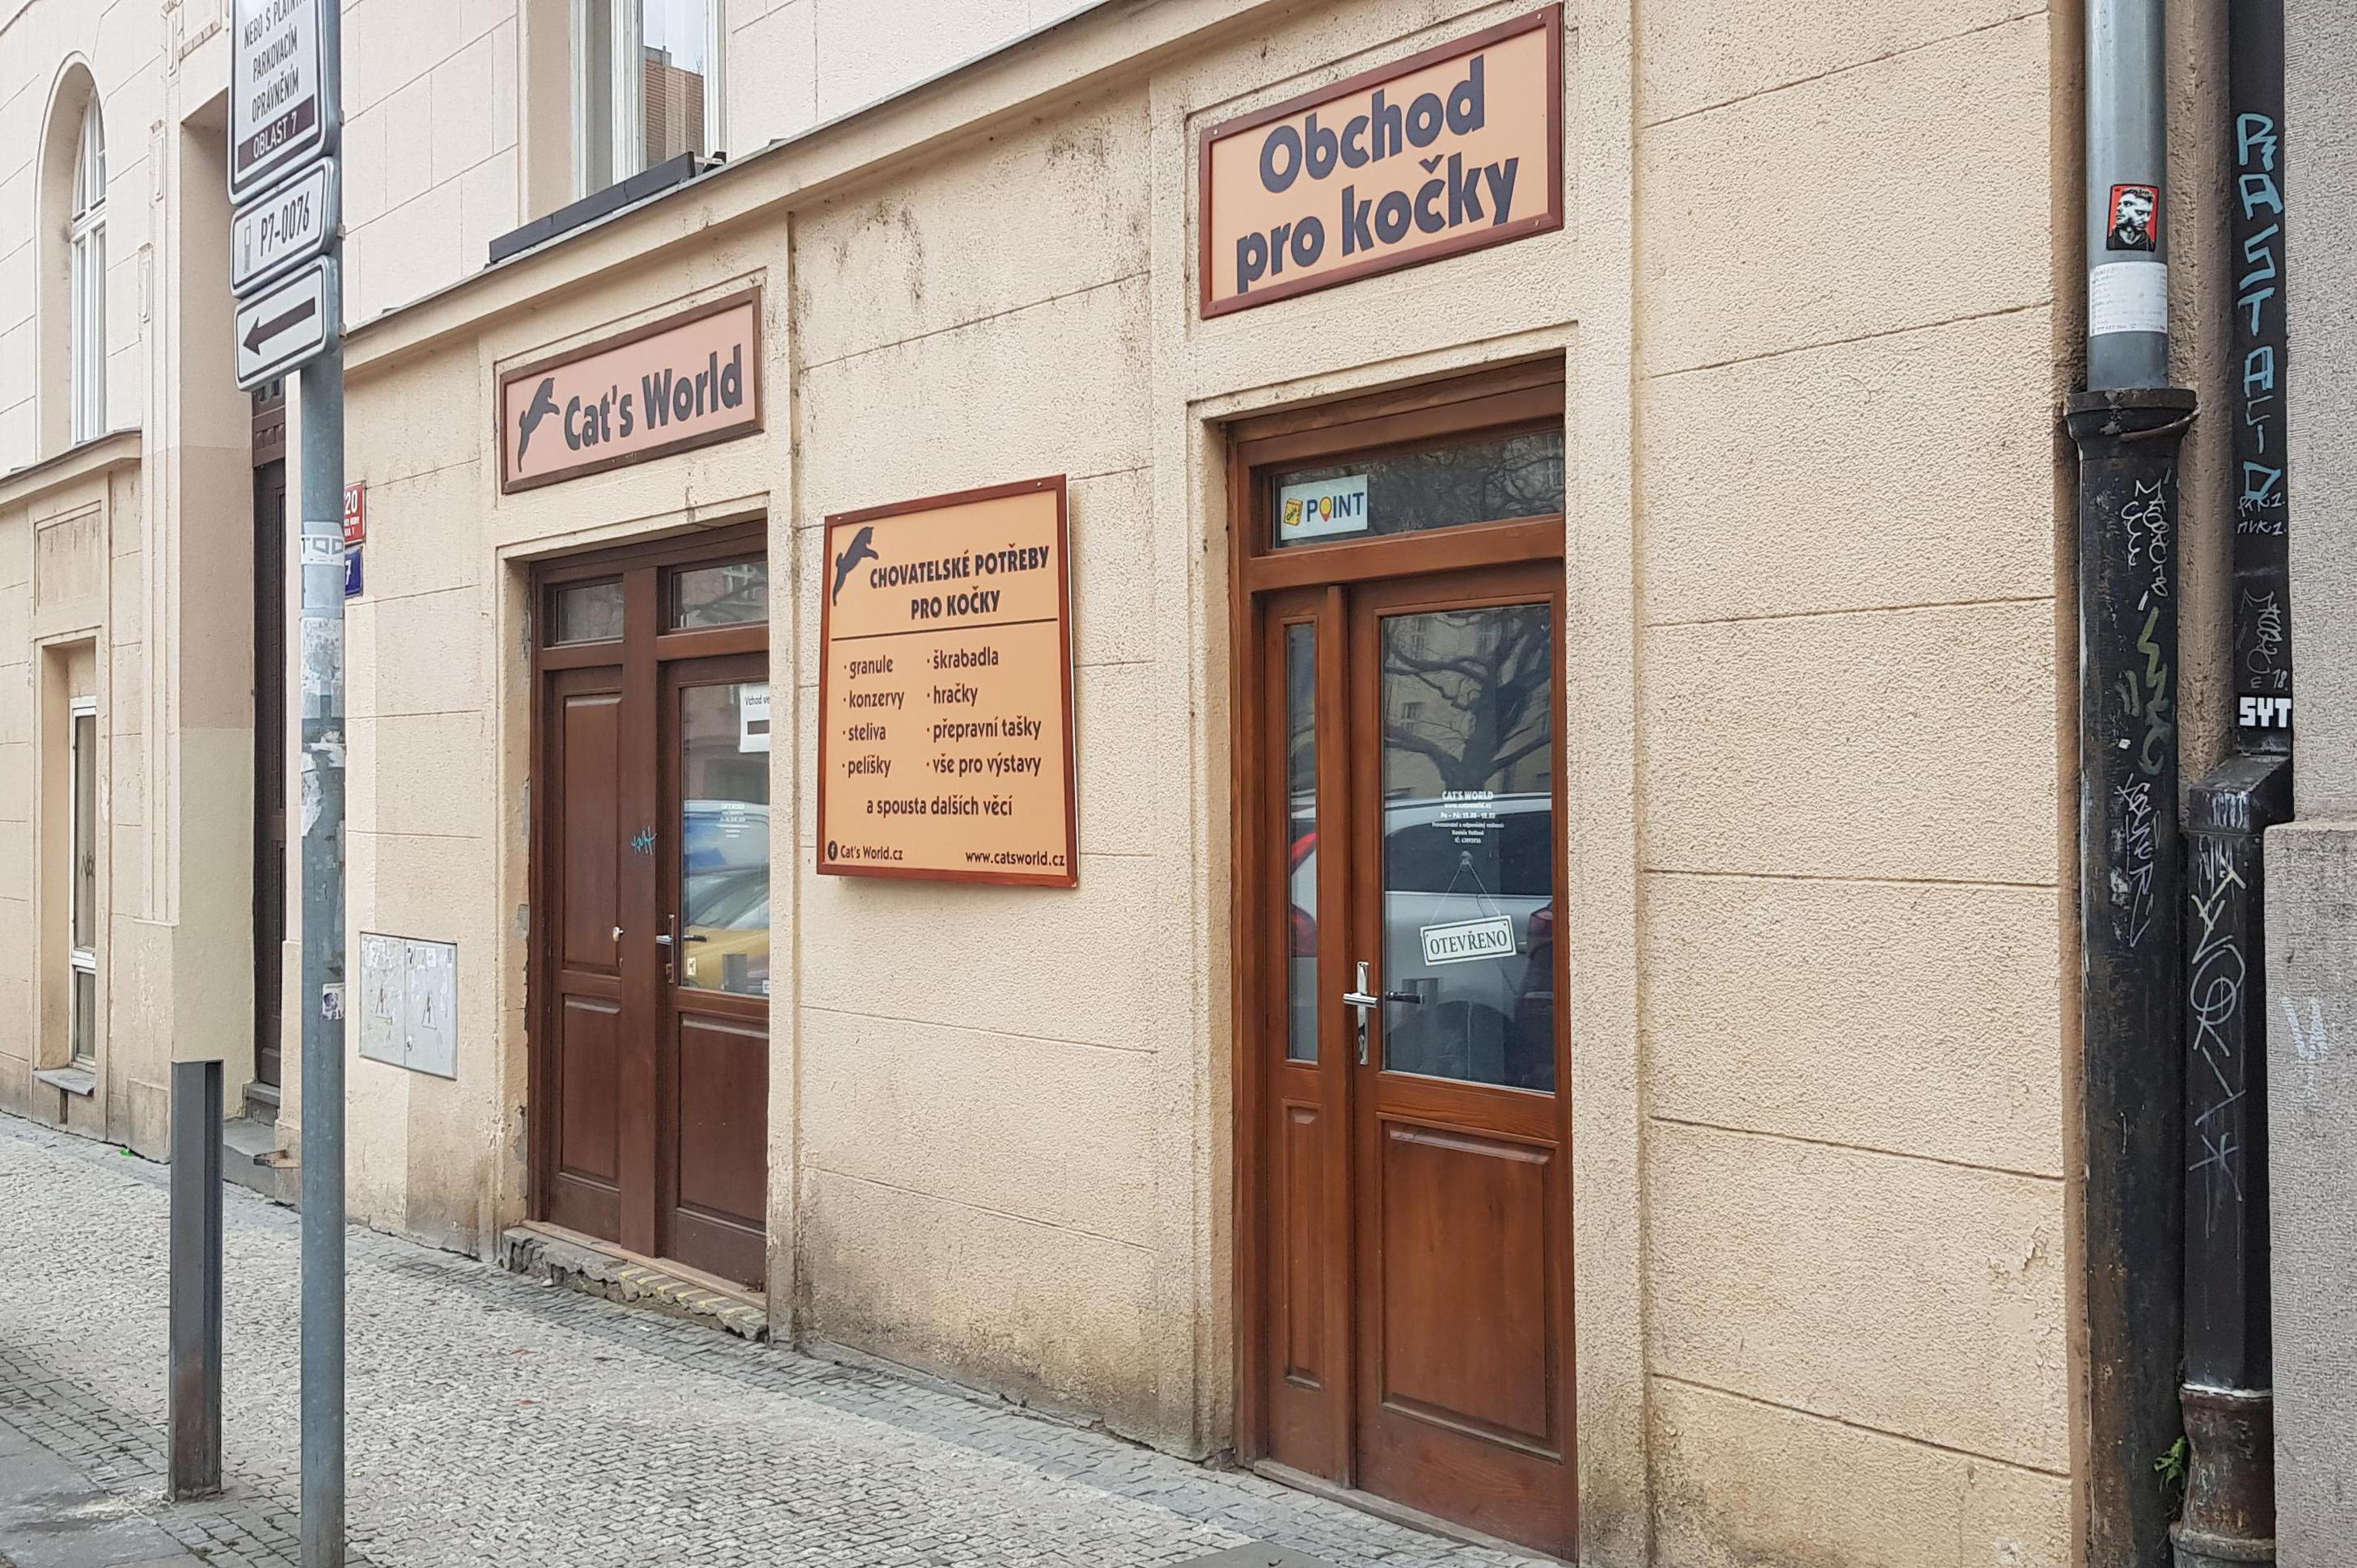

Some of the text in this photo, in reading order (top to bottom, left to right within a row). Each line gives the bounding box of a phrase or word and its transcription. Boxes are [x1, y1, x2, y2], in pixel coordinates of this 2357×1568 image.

[244, 14, 263, 49] NEBO
[265, 7, 271, 32] S
[252, 23, 298, 83] PARKOVACÍM
[252, 65, 299, 122] OPRÁVNĚNÍM
[253, 111, 298, 158] OBLAST 7
[1259, 54, 1485, 193] Obchod
[260, 191, 310, 257] P7-0076
[1236, 152, 1520, 295] pro kočky
[564, 343, 743, 451] Cat's World
[345, 489, 358, 514] 20
[870, 543, 1050, 589] CHOVATELSKÉ POTŘEBY
[911, 585, 1001, 619] PRO KOČKY
[849, 655, 894, 679] granule
[933, 646, 1000, 670] škrabadla
[849, 691, 905, 710] konzervy
[933, 683, 979, 707] hračky
[2239, 697, 2292, 728] SYT
[848, 722, 887, 741] steliva
[933, 715, 1042, 743] přepravní tašky
[848, 754, 891, 778] pelíšky
[933, 752, 1042, 778] vše pro výstavy
[866, 795, 1013, 818] a spousta dalších věcí
[1464, 790, 1495, 801] WORLD
[840, 845, 861, 860] Cat's
[863, 846, 903, 861] World.cz
[966, 852, 1065, 867] www.catsworld.cz
[1430, 930, 1508, 955] OTEVŘENO
